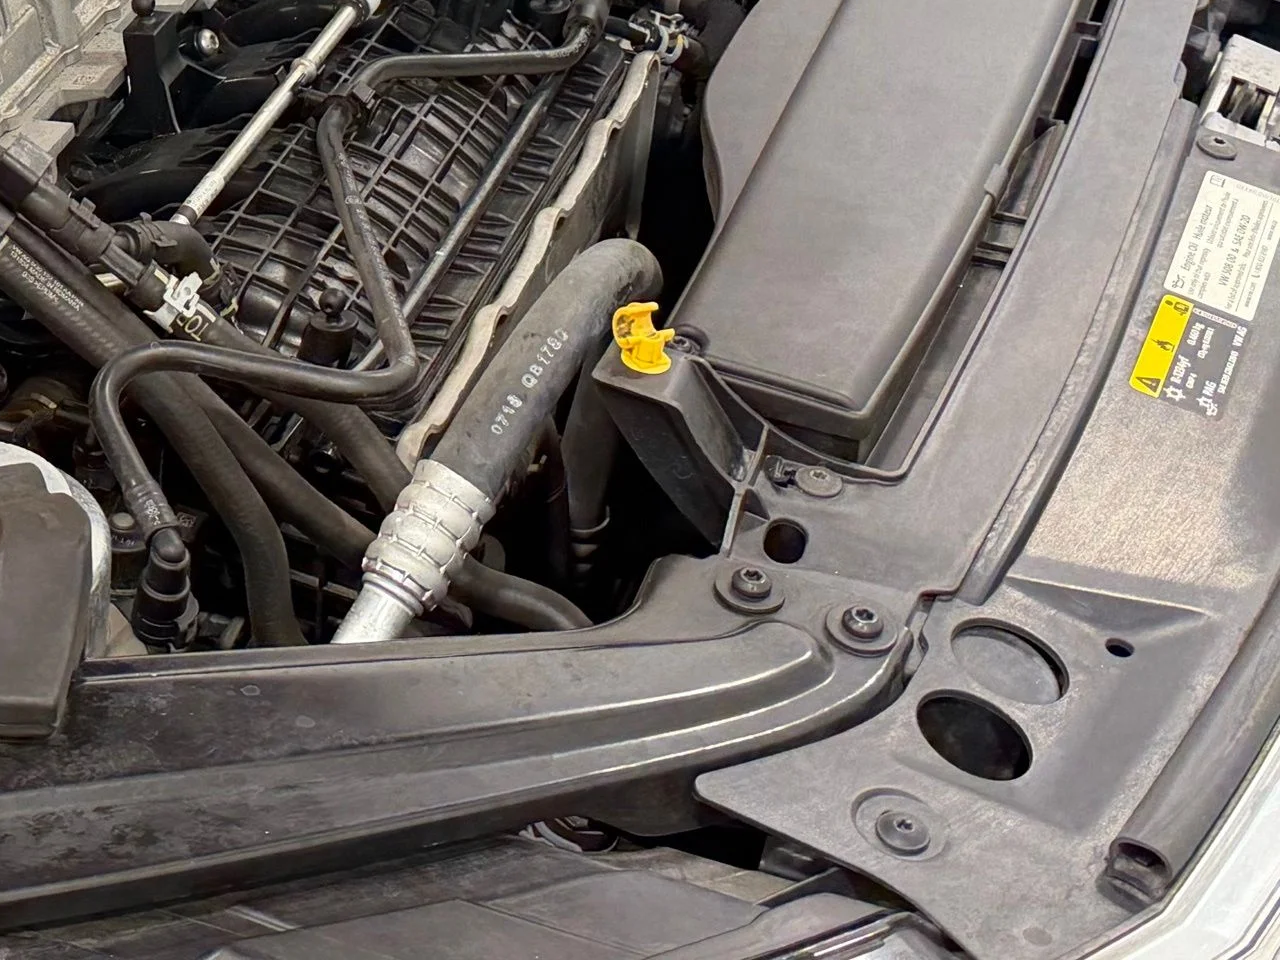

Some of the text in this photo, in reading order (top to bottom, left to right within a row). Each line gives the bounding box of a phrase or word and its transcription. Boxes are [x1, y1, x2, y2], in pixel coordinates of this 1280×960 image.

[1199, 204, 1213, 227] moteur
[1192, 226, 1205, 241] Huile
[1188, 242, 1198, 252] Oil
[1180, 252, 1196, 272] Engine
[1217, 273, 1229, 287] VW
[1232, 232, 1244, 246] SAE
[1202, 380, 1217, 397] PAG
